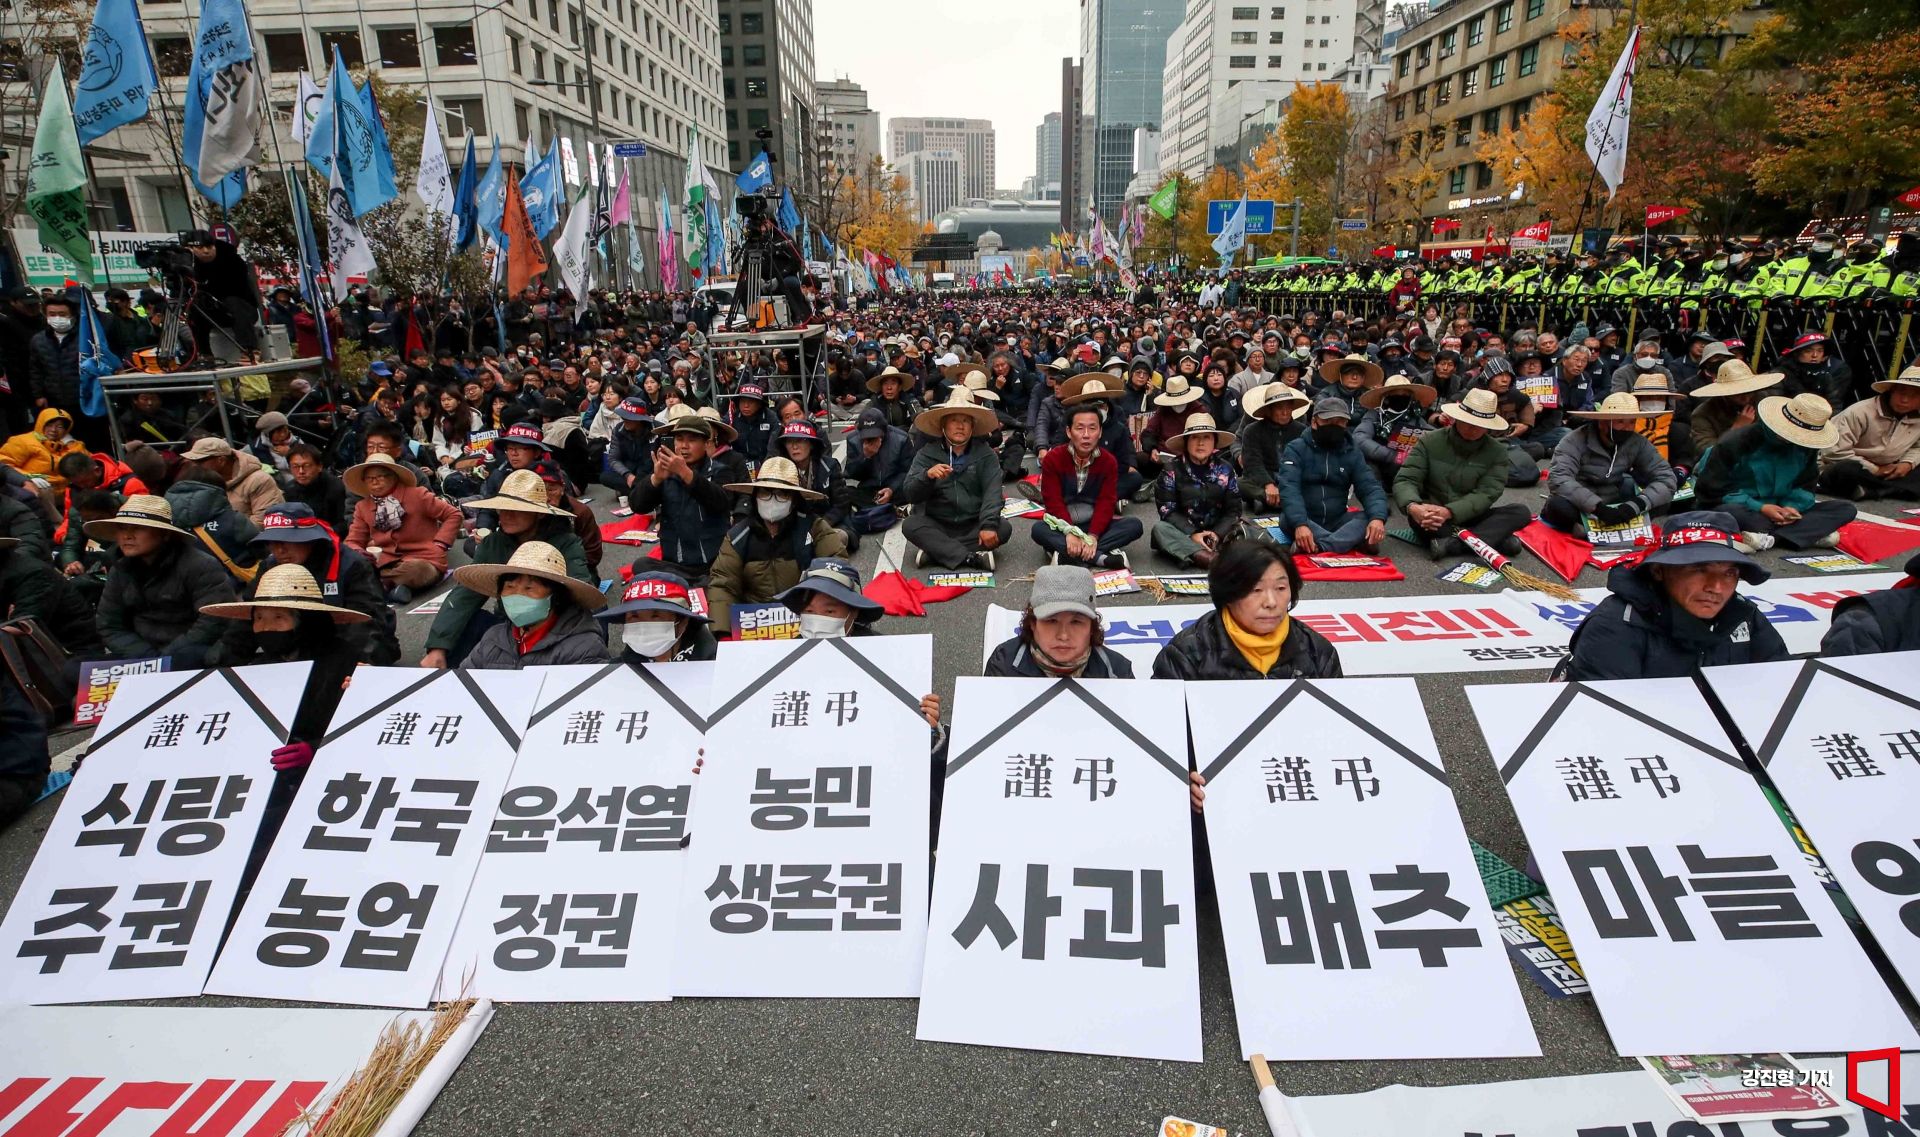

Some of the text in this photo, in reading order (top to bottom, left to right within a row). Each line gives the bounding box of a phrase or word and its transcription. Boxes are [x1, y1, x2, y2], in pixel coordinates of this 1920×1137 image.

[1451, 249, 1472, 259] HOLLYS
[75, 775, 252, 857] 식량
[303, 773, 479, 857] 한국
[485, 786, 689, 852] 윤석열
[750, 766, 871, 830] 농민
[17, 880, 212, 974] 주권
[256, 879, 438, 971] 농업
[494, 893, 638, 971] 정권
[705, 864, 901, 933] 생존권
[952, 864, 1179, 968] 사과
[1250, 865, 1482, 969] 배추
[1562, 845, 1822, 941] 마늘
